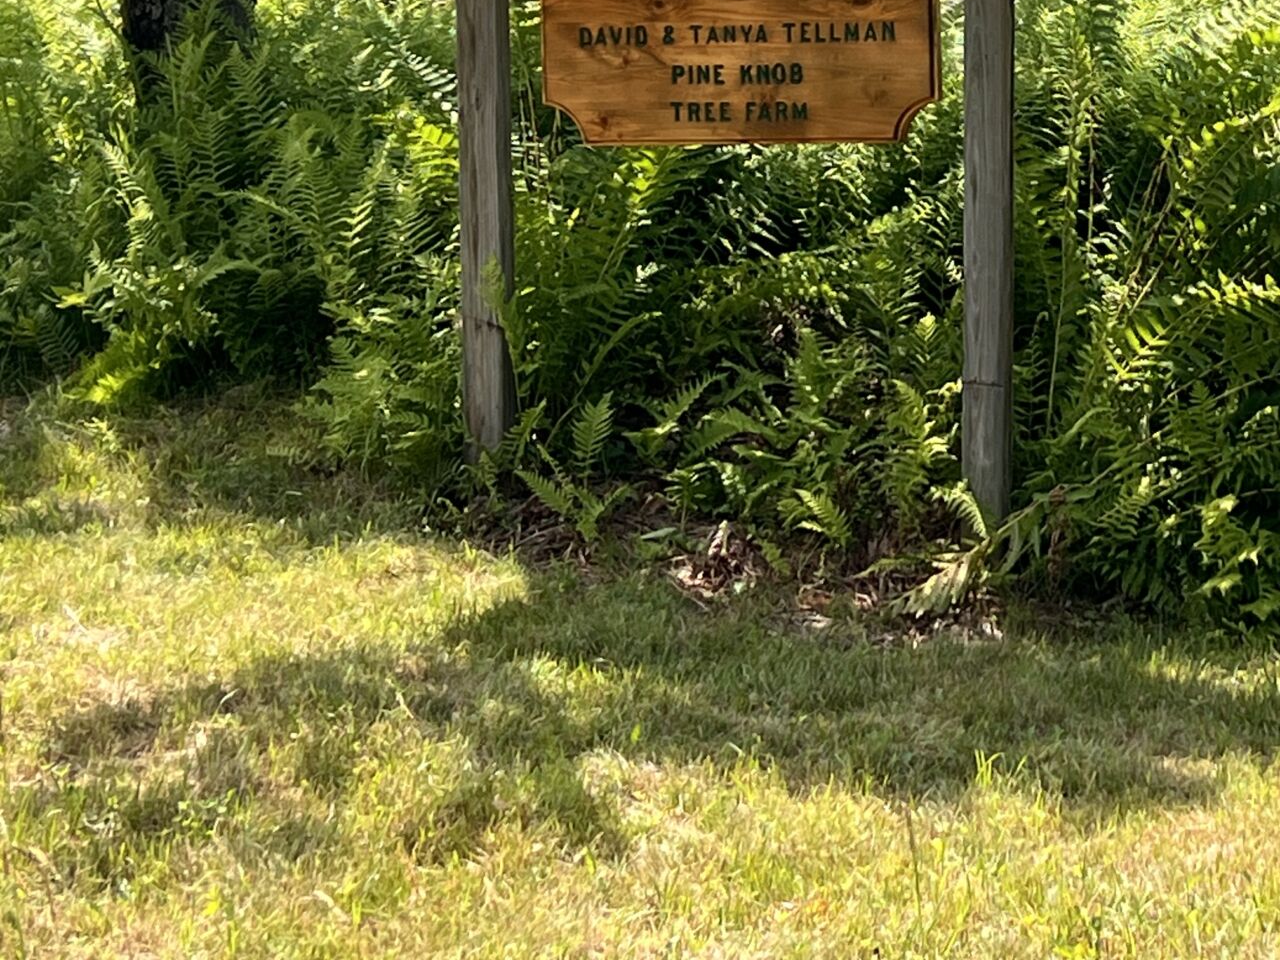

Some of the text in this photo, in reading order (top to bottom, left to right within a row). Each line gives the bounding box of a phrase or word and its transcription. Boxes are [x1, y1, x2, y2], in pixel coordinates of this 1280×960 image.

[578, 21, 896, 49] DAVID & TANYA TELLMAN
[671, 64, 804, 85] PINE KNOB
[670, 102, 808, 123] TREE FARM
